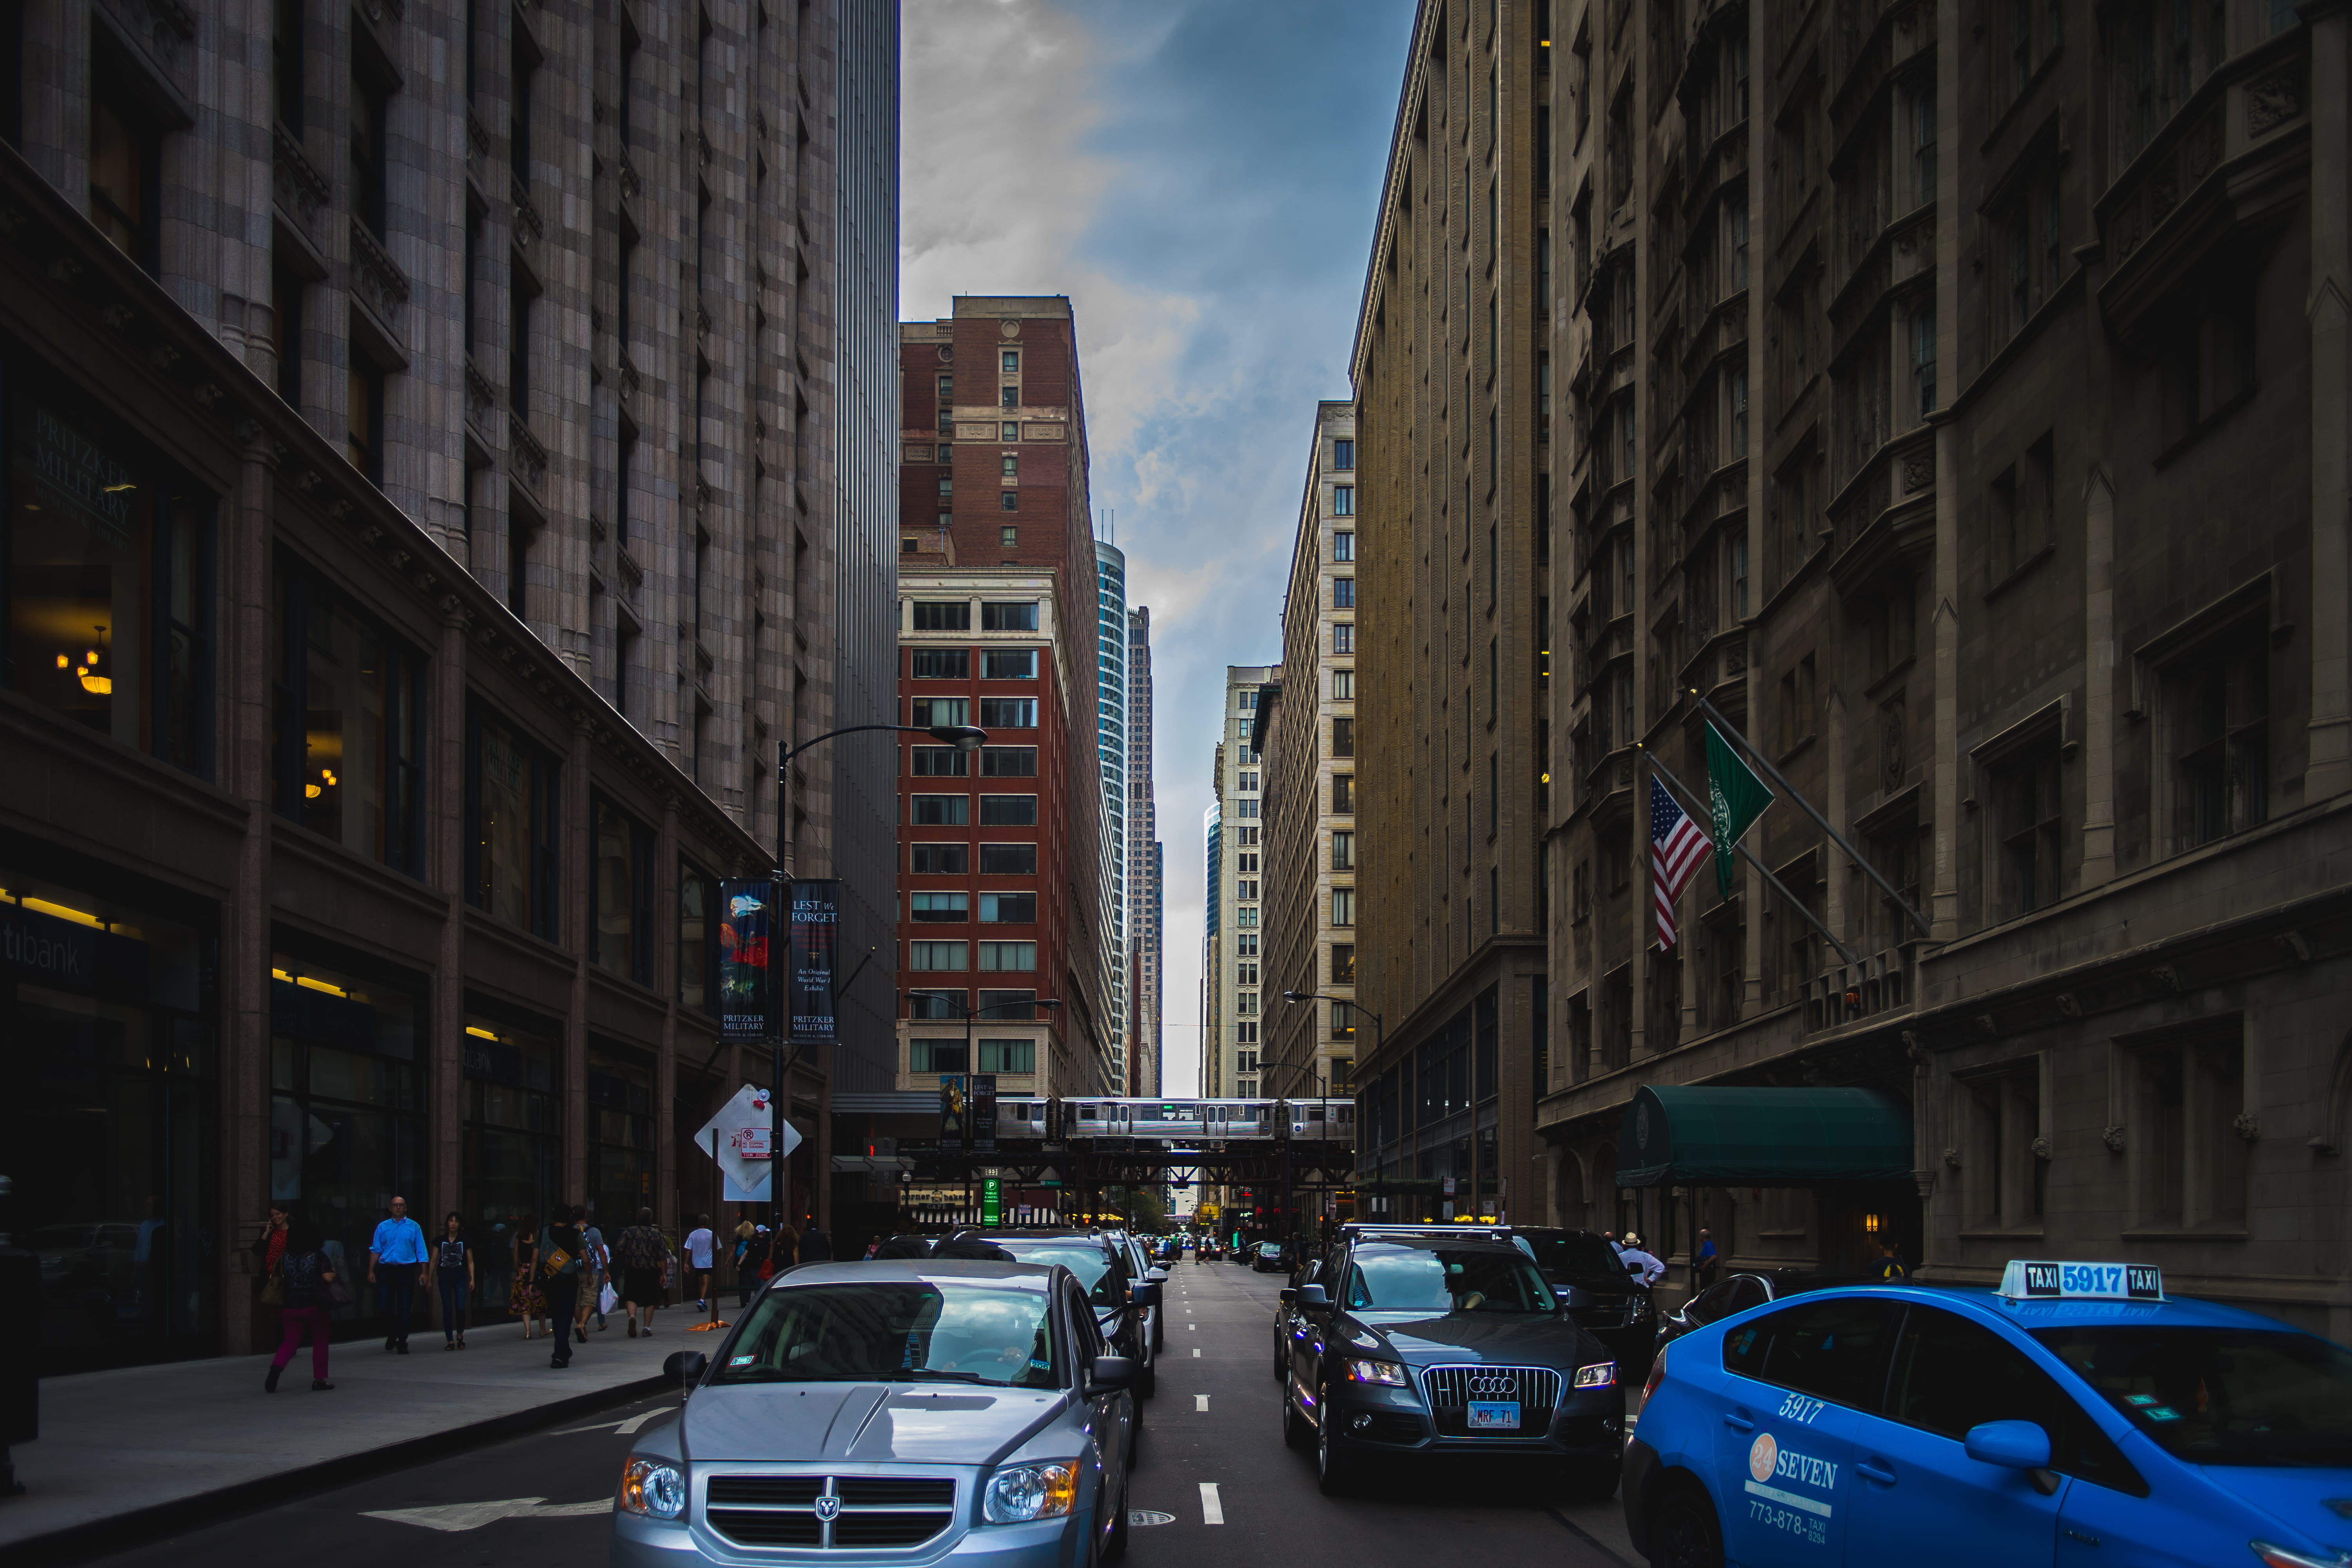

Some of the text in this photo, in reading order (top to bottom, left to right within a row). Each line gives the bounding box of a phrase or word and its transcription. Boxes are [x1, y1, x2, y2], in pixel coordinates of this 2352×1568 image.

[37, 407, 131, 497] PRITZKER
[35, 441, 130, 526] MILITARY
[35, 483, 78, 521] MUSEUM
[91, 521, 129, 554] LIBRARY
[792, 912, 837, 922] FORGET
[794, 901, 821, 910] LEST
[2027, 1267, 2057, 1288] TAXI
[2063, 1266, 2122, 1292] 5917
[2129, 1269, 2156, 1290] TAXI
[1477, 1409, 1511, 1423] MRF 71
[1779, 1393, 1826, 1424] 5917
[1752, 1443, 1838, 1490] 24 SEVEN
[1750, 1500, 1807, 1535] 773-878-
[1809, 1517, 1826, 1533] TAXI
[1808, 1531, 1826, 1546] 8294
